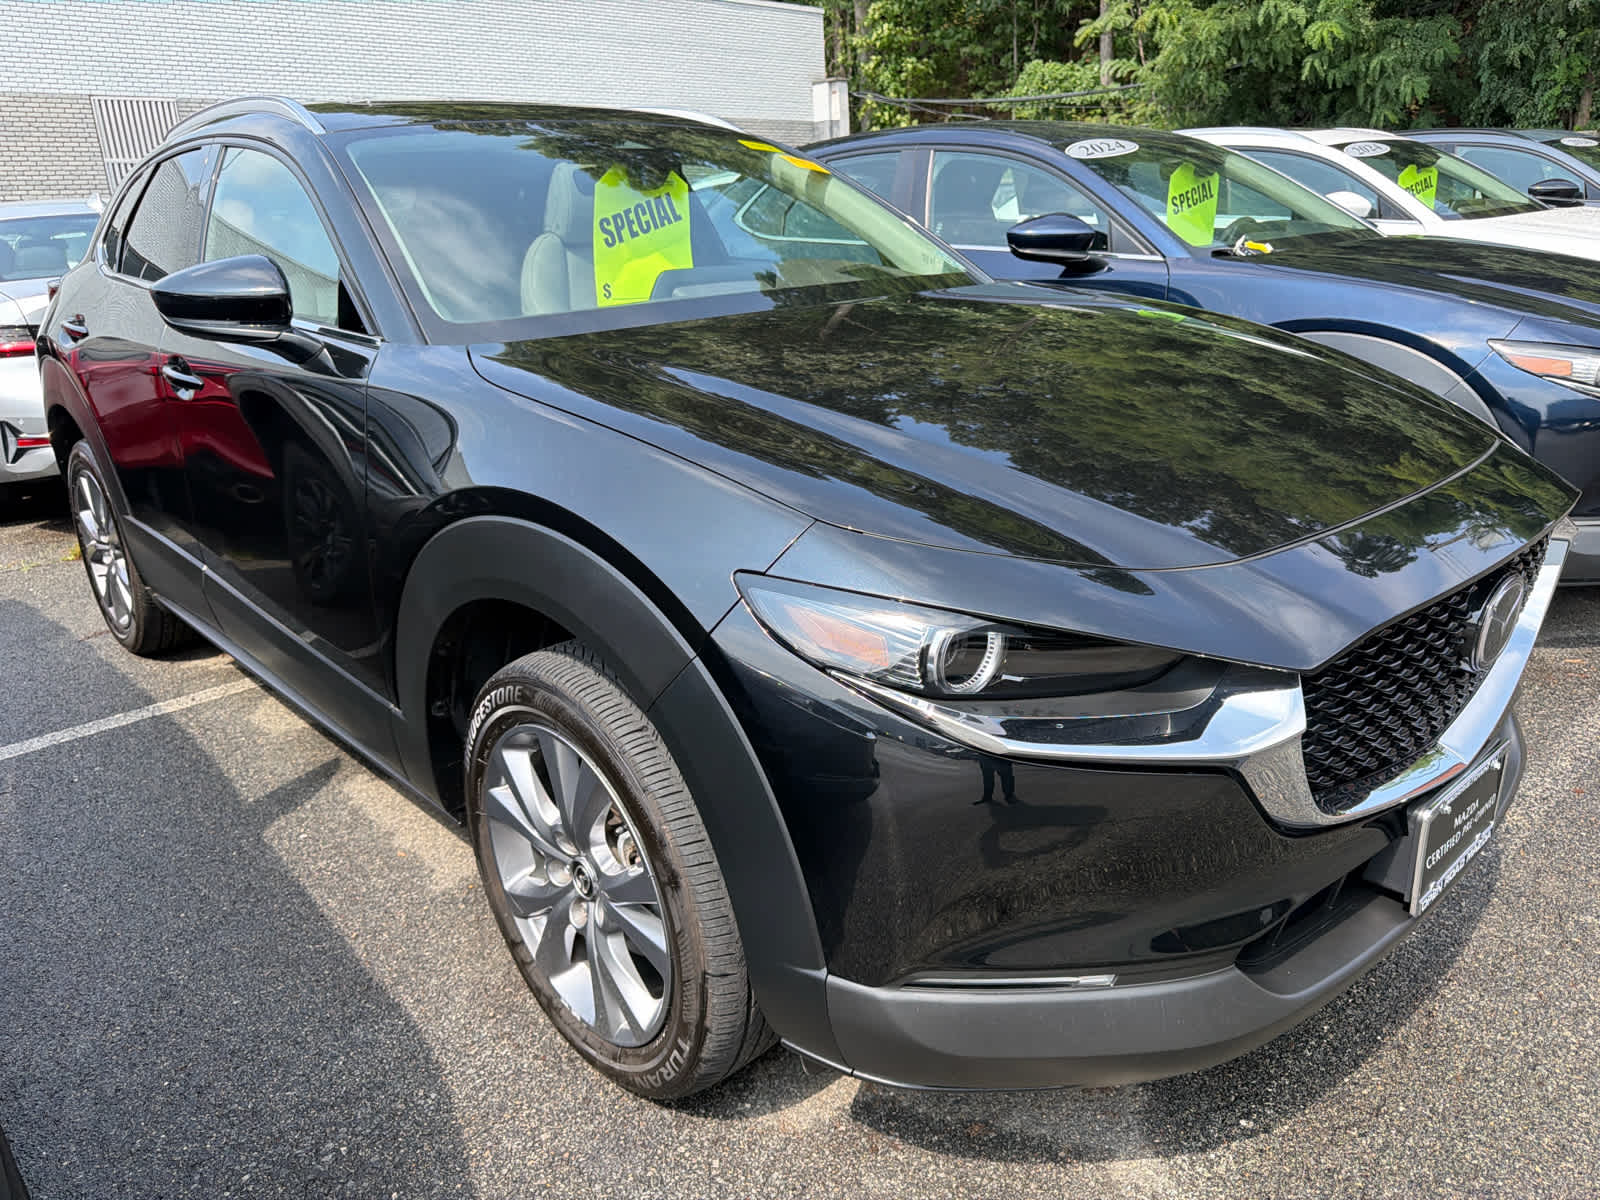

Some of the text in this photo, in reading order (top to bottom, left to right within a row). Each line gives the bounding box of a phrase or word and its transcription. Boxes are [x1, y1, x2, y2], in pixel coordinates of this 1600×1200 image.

[1079, 141, 1126, 156] 2024
[1352, 143, 1383, 155] 2024
[1171, 180, 1214, 215] SPECIAL
[598, 192, 682, 248] SPECIAL
[603, 283, 612, 299] $
[1453, 799, 1480, 827] MAZDA
[1426, 831, 1462, 869] CERTIFIED
[635, 1037, 690, 1088] TURAN
